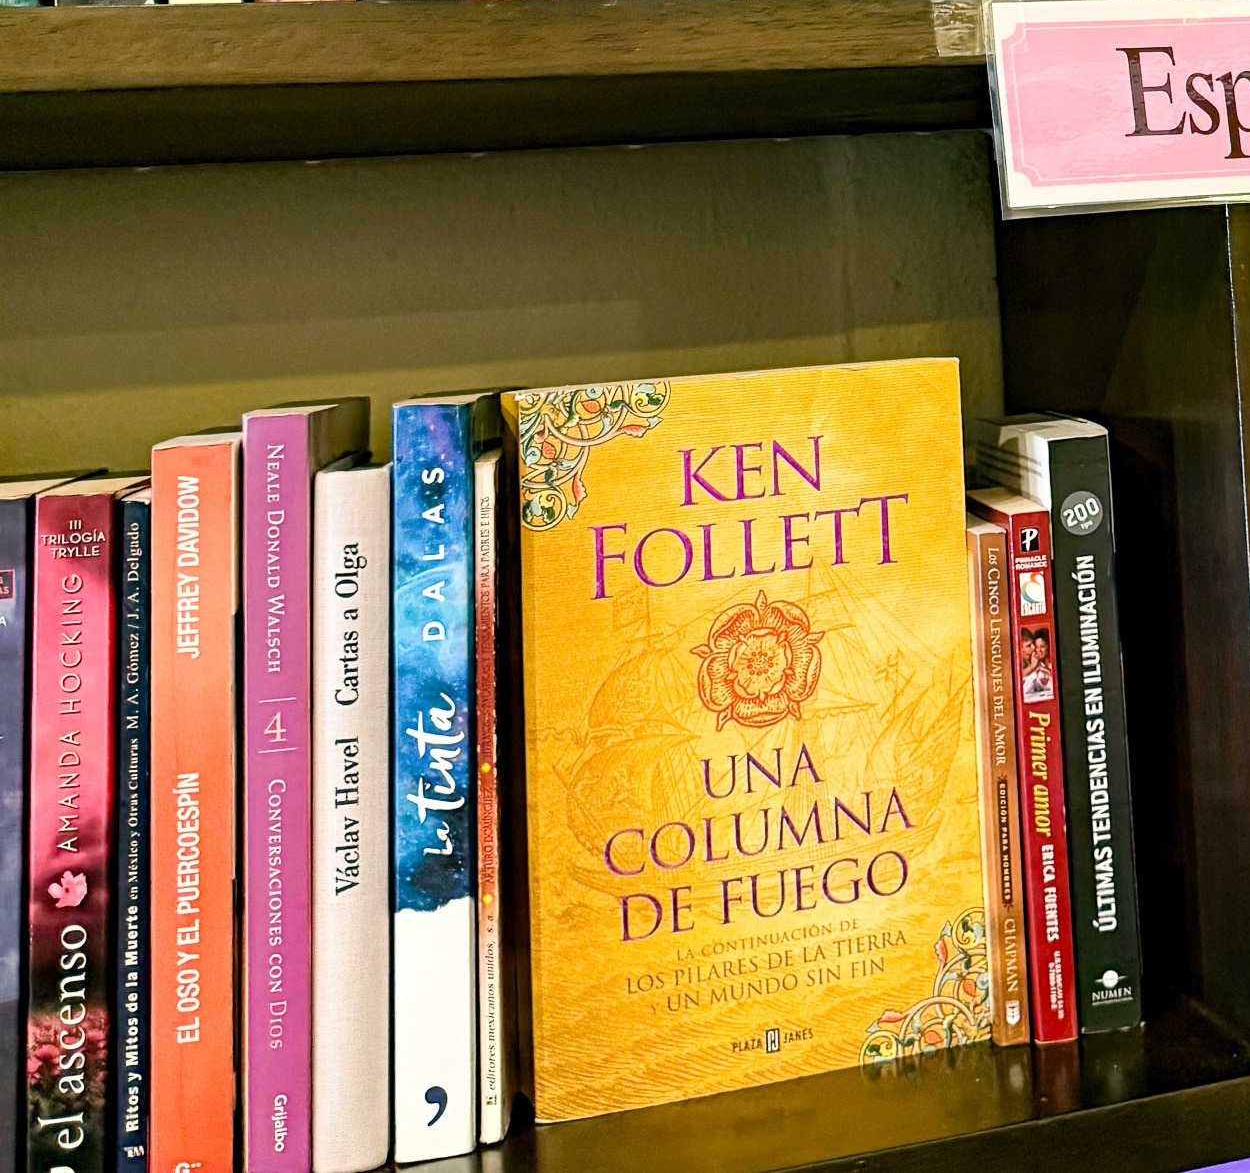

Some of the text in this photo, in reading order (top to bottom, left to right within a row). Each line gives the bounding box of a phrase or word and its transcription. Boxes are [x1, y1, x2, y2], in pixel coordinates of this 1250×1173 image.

[41, 531, 106, 545] TRILOGÍA
[677, 436, 825, 507] KEN
[51, 546, 100, 559] TRYLLE
[177, 475, 200, 659] JEFFREY DAVIDOW
[266, 444, 285, 674] NEALE DONALD WALSCH
[422, 467, 446, 642] DALAS
[589, 494, 909, 601] FOLLETT
[334, 543, 367, 707] Cartas a Olga
[57, 573, 83, 853] AMANDA HOCKING
[701, 742, 824, 800] UNA
[1029, 711, 1052, 837] Primer amor
[1072, 555, 1116, 932] ÚLTIMAS TENDENCIAS EN ILUMINACIÓN
[335, 736, 361, 896] Václav Havel
[604, 787, 918, 877] COLUMNA
[171, 771, 200, 1044] EL OSO Y EL PUERCOESPÍN
[619, 851, 909, 942] DE FUEGO
[37, 924, 87, 1150] el ascenso
[271, 1094, 288, 1152] Grijalbo
